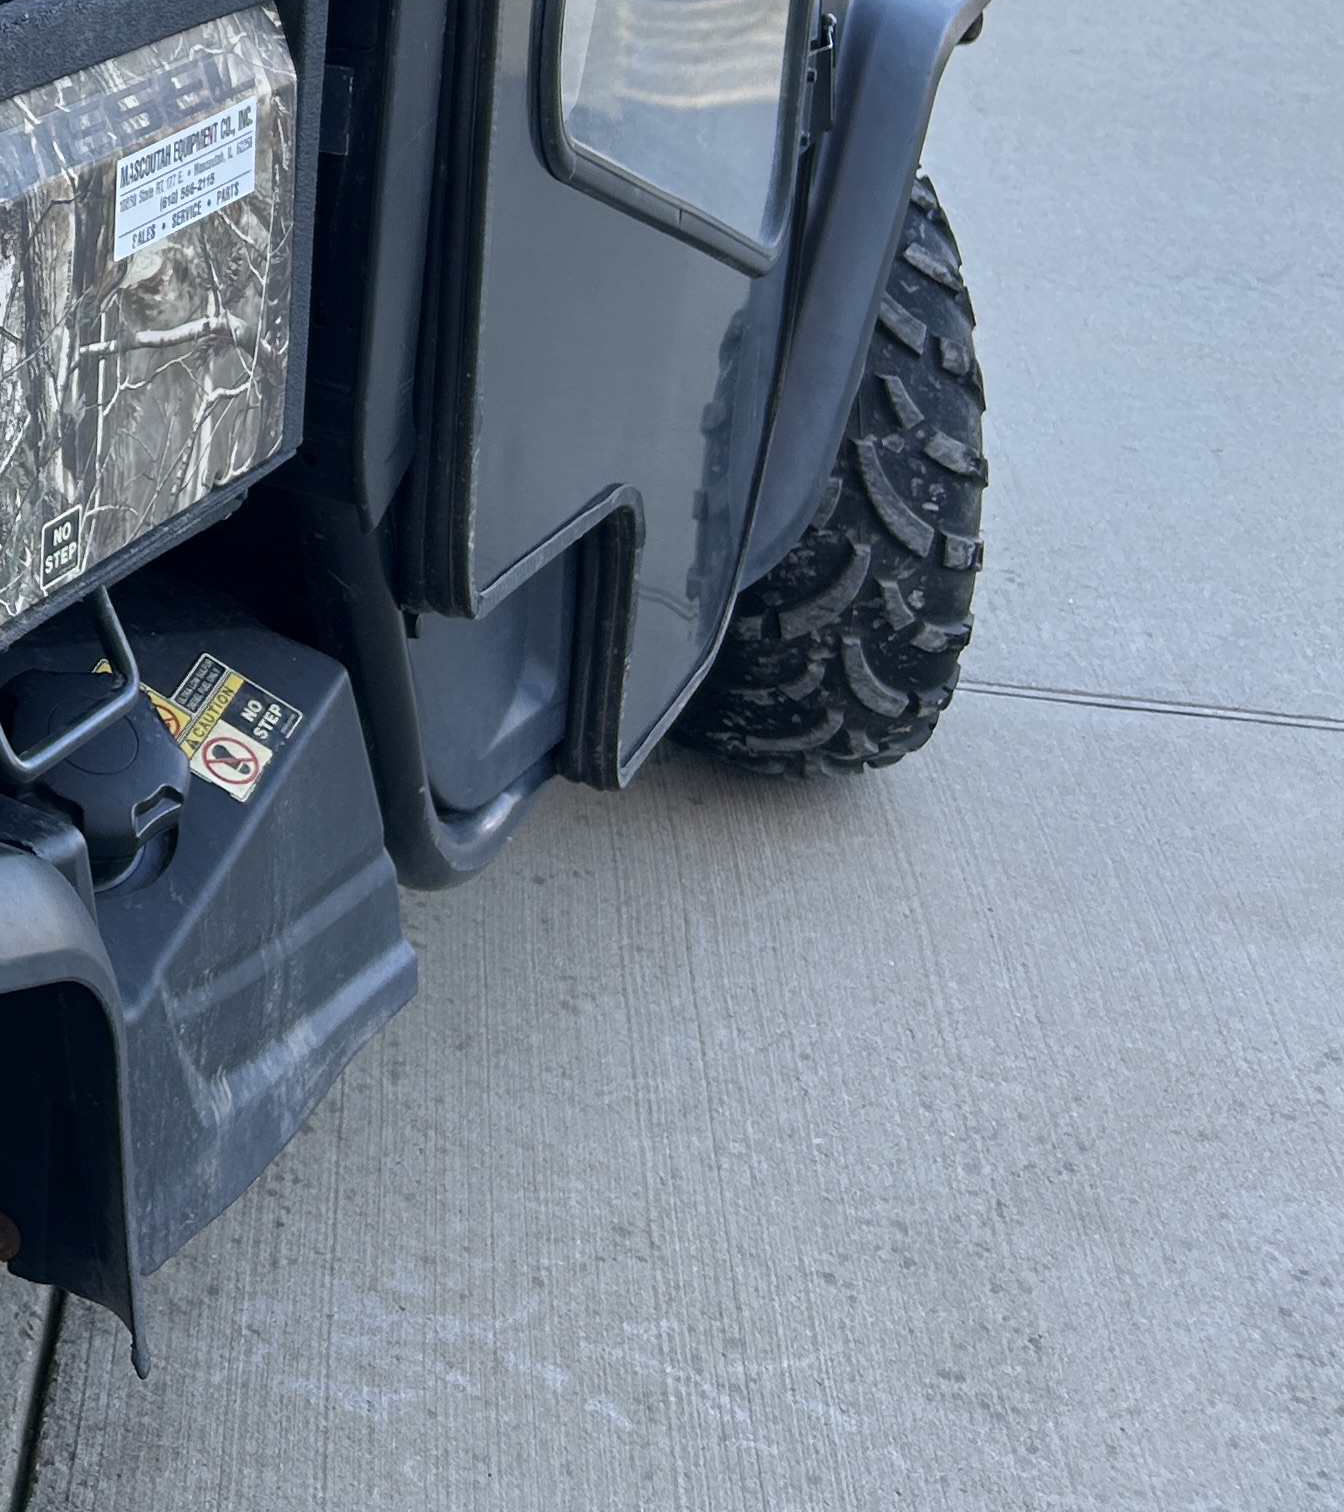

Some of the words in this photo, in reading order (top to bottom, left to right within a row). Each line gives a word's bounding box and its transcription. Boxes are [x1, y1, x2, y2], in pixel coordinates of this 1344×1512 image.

[120, 142, 171, 188] MASCOUTAH
[173, 122, 218, 162] EQUIPMENT
[132, 224, 156, 249] SALES
[172, 201, 202, 228] SERVICE
[216, 182, 240, 205] PARTS
[53, 521, 72, 546] NO
[45, 541, 77, 574] STEP
[193, 685, 235, 738] CAUTION
[240, 699, 262, 722] NO
[253, 703, 282, 740] STEP
